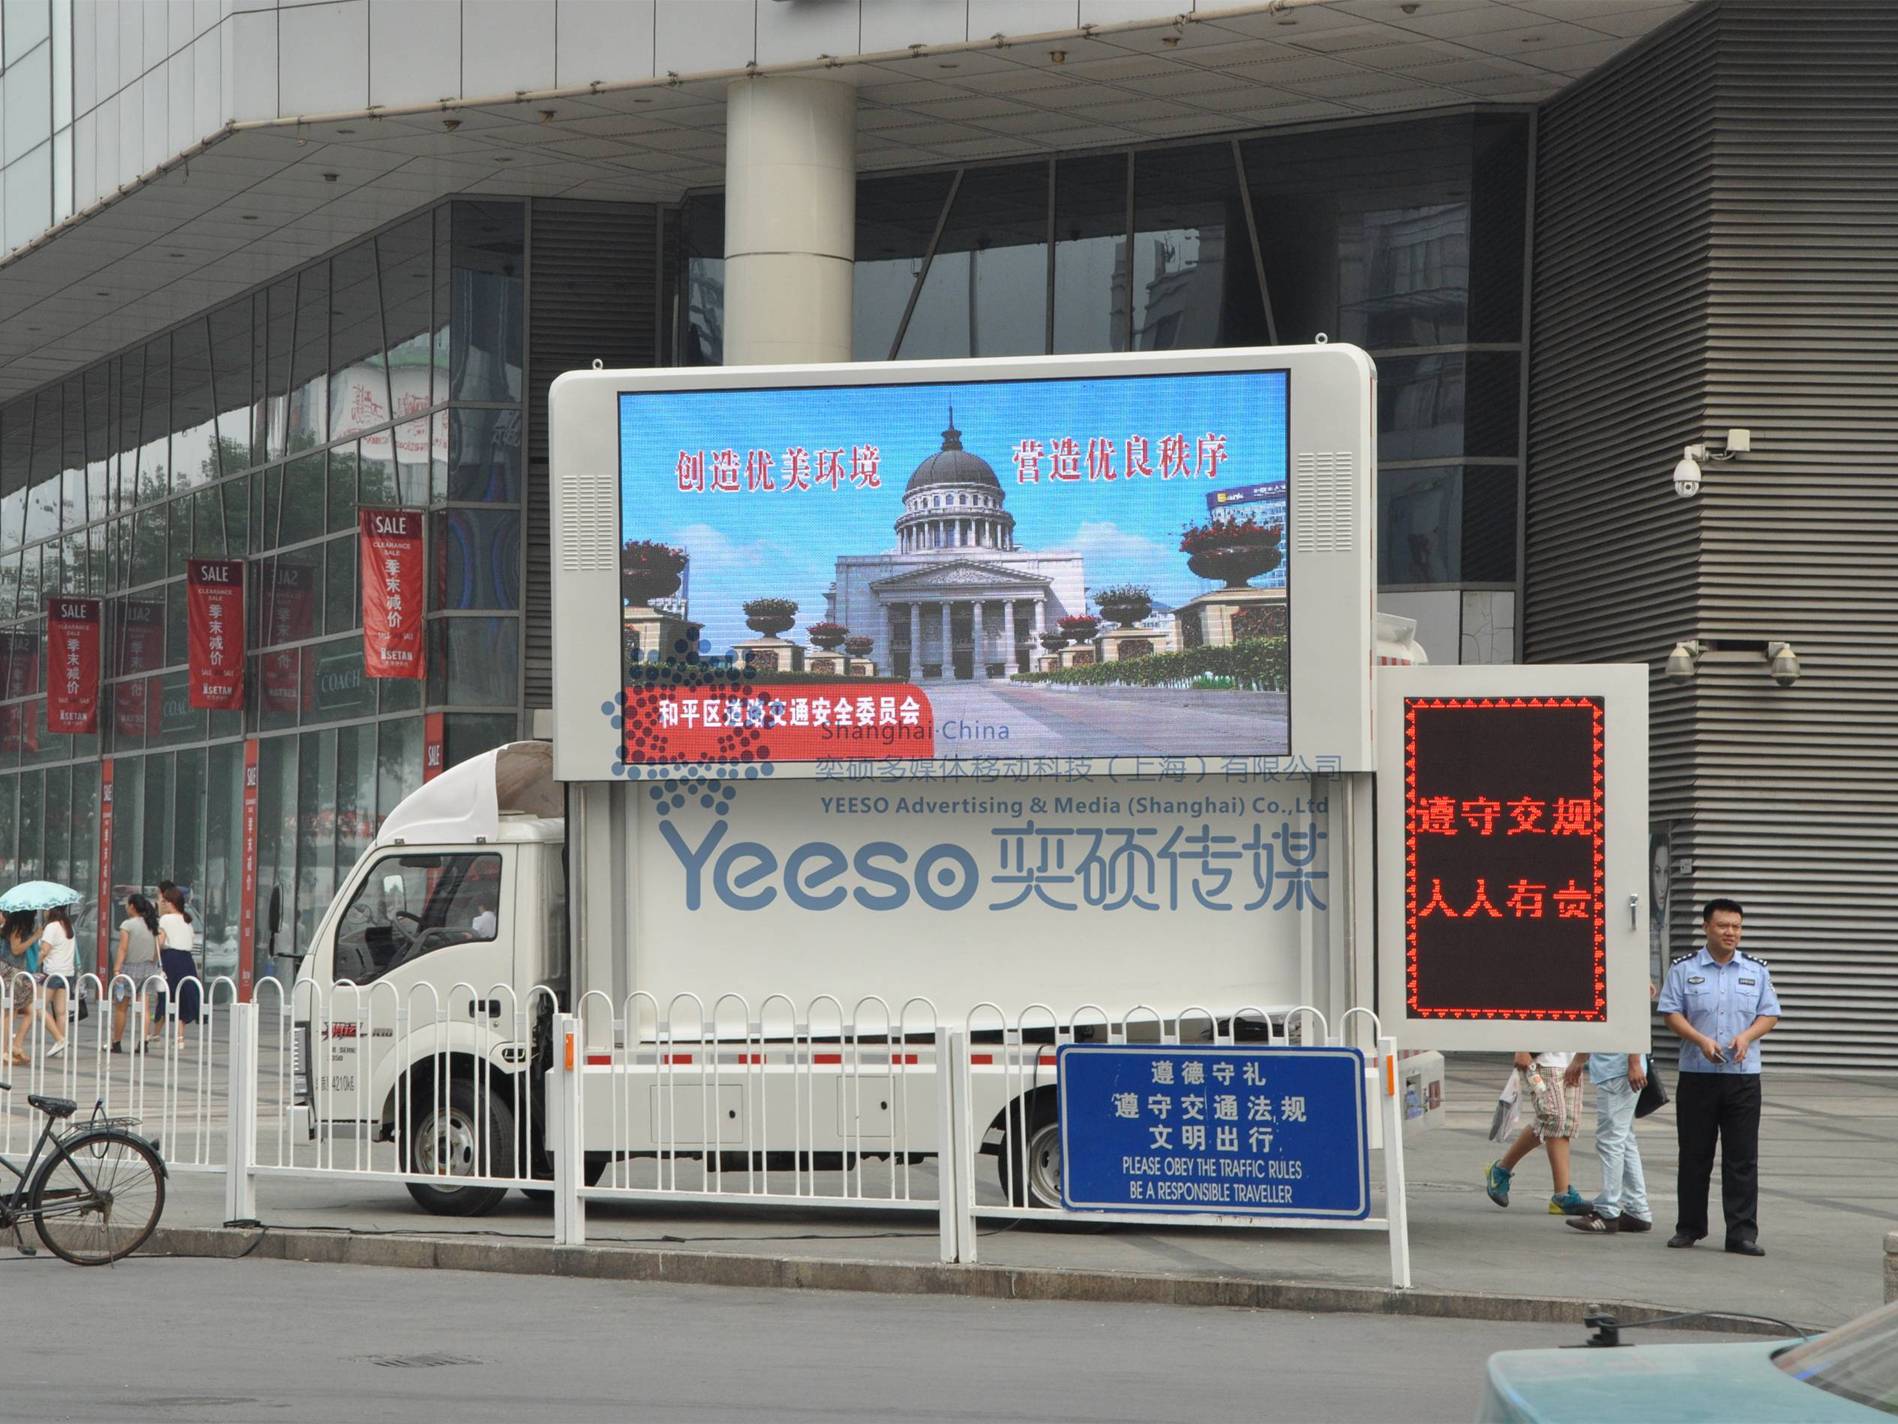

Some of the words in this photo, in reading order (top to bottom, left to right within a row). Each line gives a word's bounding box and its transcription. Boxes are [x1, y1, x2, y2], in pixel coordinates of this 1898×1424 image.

[675, 443, 881, 492] 创造优美环境
[1012, 432, 1228, 484] 营造优良秩序
[376, 516, 407, 534] SALE
[373, 542, 411, 550] CLEARANCE
[201, 566, 229, 582] SALE
[385, 559, 402, 628] 季末减价
[61, 604, 87, 618] SALE
[208, 604, 224, 665] 季末减价
[428, 744, 440, 766] SALE
[1416, 796, 1593, 836] 遵守交规
[1418, 878, 1592, 918] 人人有责
[1151, 1060, 1266, 1086] 遵德守礼
[1113, 1092, 1307, 1122] 遵守交通法规
[1149, 1124, 1273, 1153] 文明出行
[1122, 1156, 1161, 1175] PLEASE
[1164, 1158, 1194, 1176] OBEY
[1196, 1158, 1217, 1177] THE
[1219, 1159, 1265, 1178] TRAFFIC
[1268, 1160, 1302, 1179] RULES
[1130, 1181, 1143, 1199] BE
[1146, 1182, 1156, 1199] A
[1158, 1182, 1230, 1202] RESPONSIBLE
[1233, 1183, 1293, 1203] TRAVELLER
